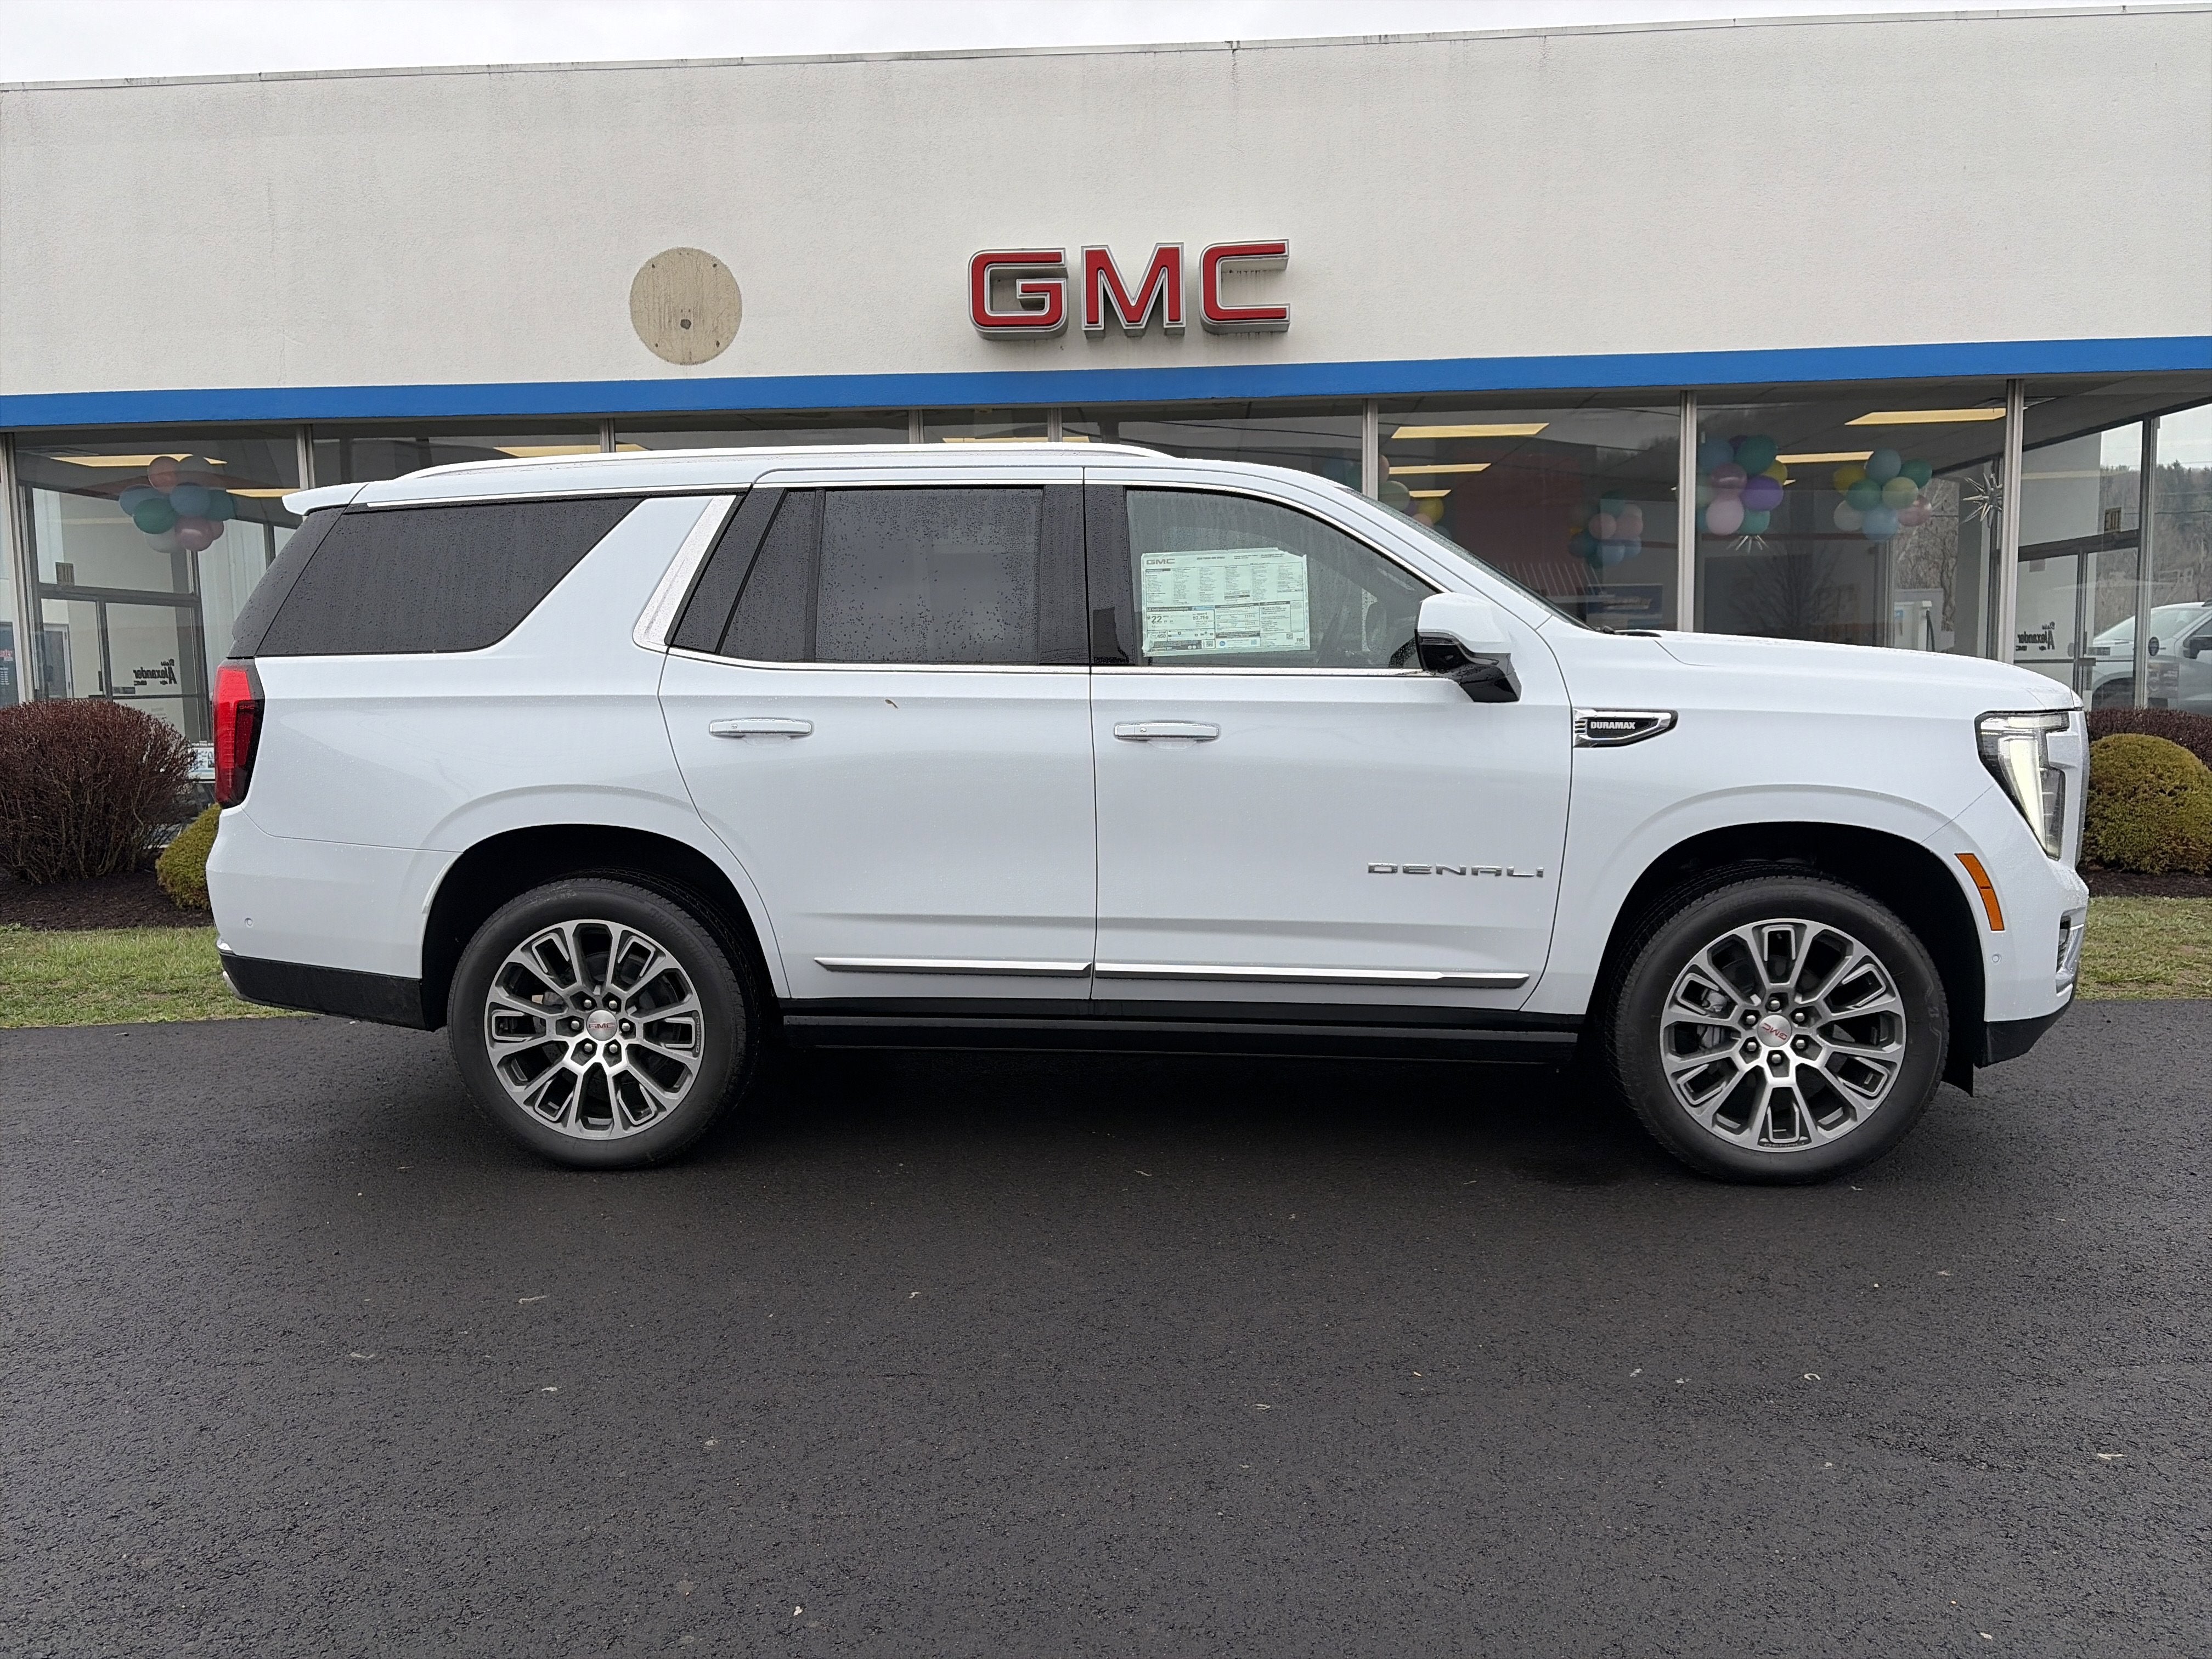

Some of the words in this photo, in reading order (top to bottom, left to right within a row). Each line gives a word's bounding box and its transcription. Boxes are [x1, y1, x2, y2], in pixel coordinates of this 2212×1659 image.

[968, 239, 1290, 336] GMC
[1590, 721, 1636, 730] DURAMAX
[1368, 862, 1544, 878] DENALI
[1762, 1023, 1788, 1041] GMC
